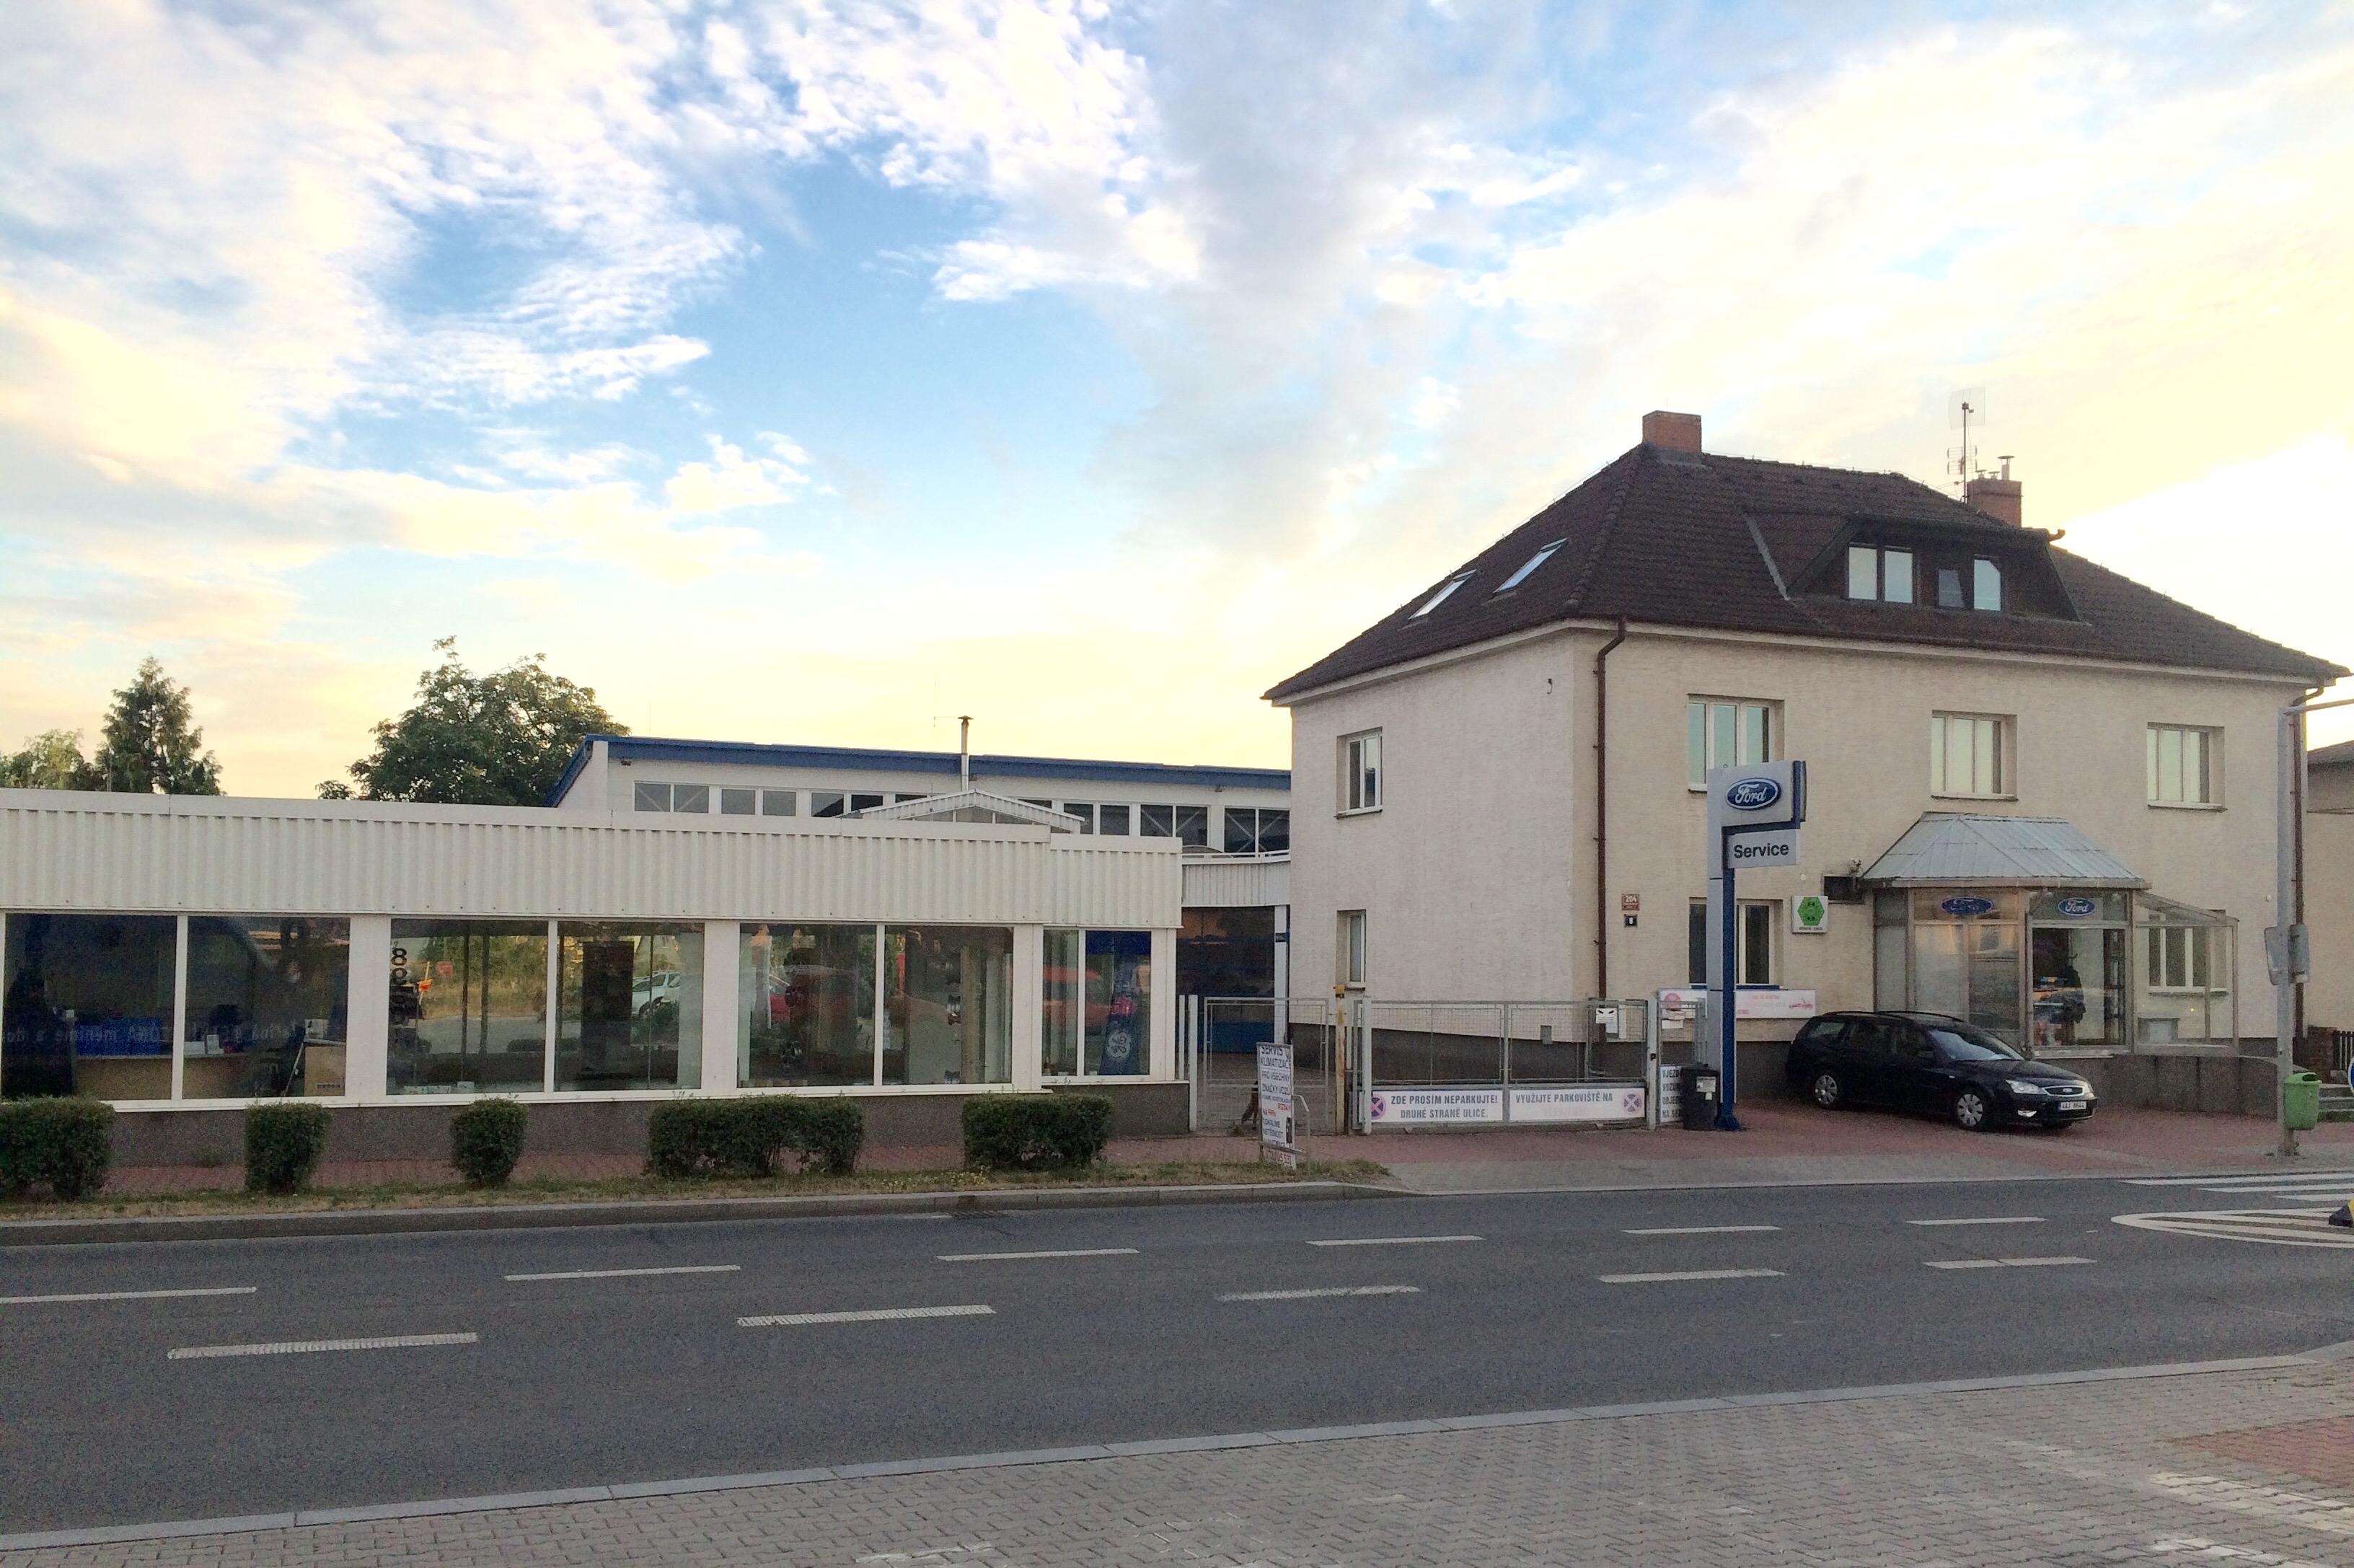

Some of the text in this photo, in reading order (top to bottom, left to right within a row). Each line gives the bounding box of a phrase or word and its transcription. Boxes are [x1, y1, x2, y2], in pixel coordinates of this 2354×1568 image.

[1734, 783, 1767, 803] Ford
[1734, 842, 1789, 859] Service
[2066, 899, 2089, 913] Ford
[1261, 1046, 1283, 1056] SERVIS
[1390, 1093, 1498, 1104] ZDE PROSÍM NEPARKUJTE!
[1515, 1092, 1613, 1104] VYUŽIJTE PARKOVIŠTĚ NA
[1401, 1106, 1489, 1119] DRUHÉ STRANĚ ULICE.
